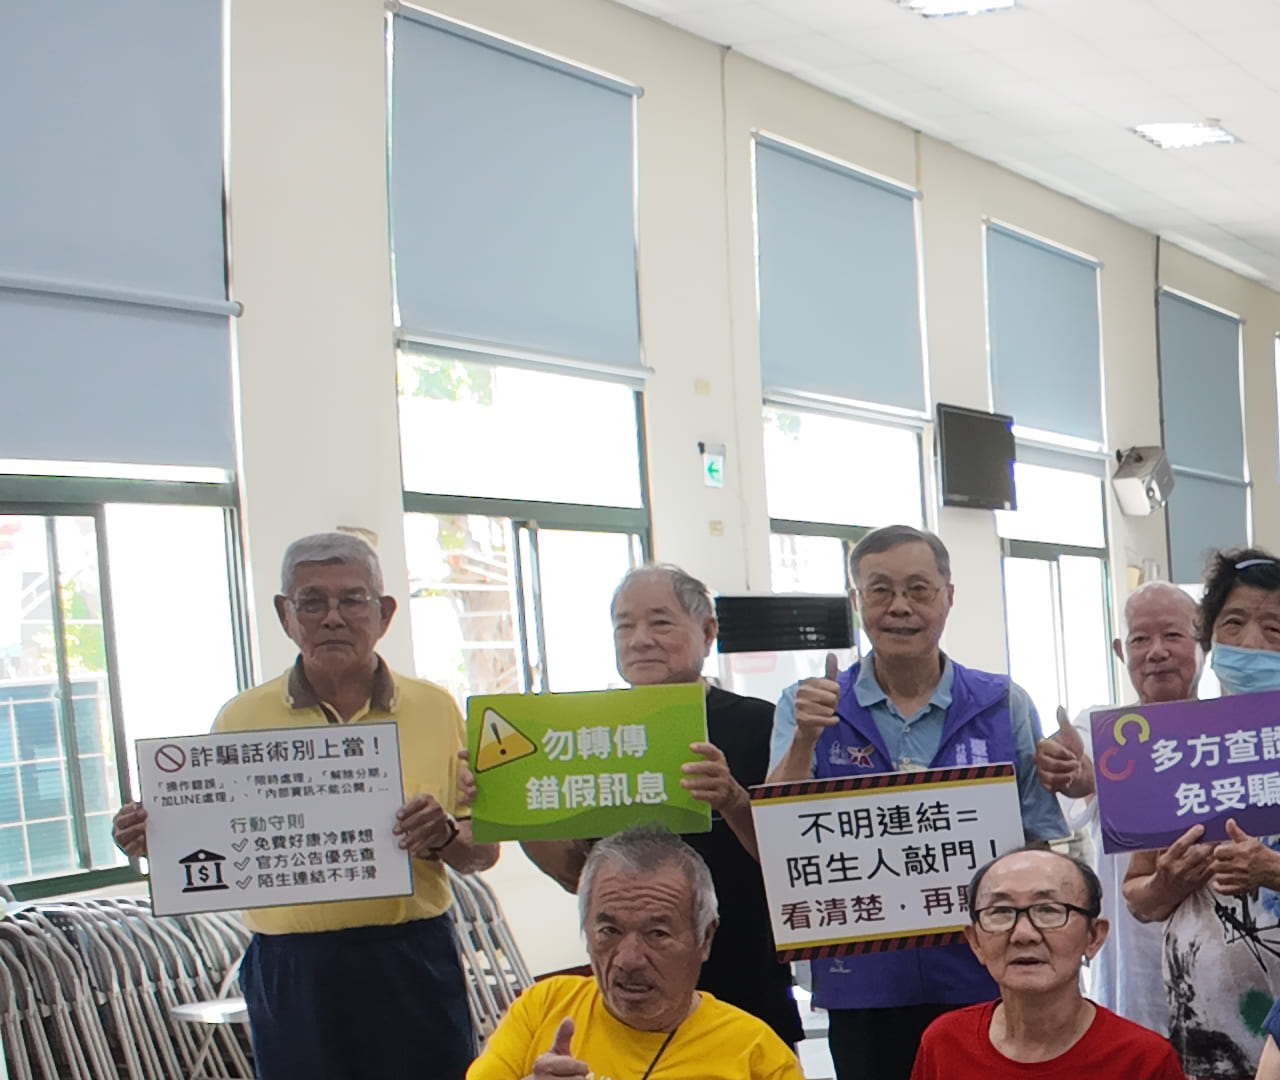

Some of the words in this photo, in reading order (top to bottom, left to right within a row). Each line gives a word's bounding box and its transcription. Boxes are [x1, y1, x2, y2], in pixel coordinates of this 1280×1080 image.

[190, 736, 381, 769] 詐騙話術別上當！
[541, 723, 649, 762] 勿轉傳
[524, 771, 669, 811] 錯假訊息
[230, 813, 305, 835] 行動守則
[797, 801, 979, 844] 不明連結=
[254, 828, 374, 852] 免費好康冷靜想
[255, 848, 377, 870] 官方公告優先查
[257, 865, 377, 888] 陌生連結不手滑
